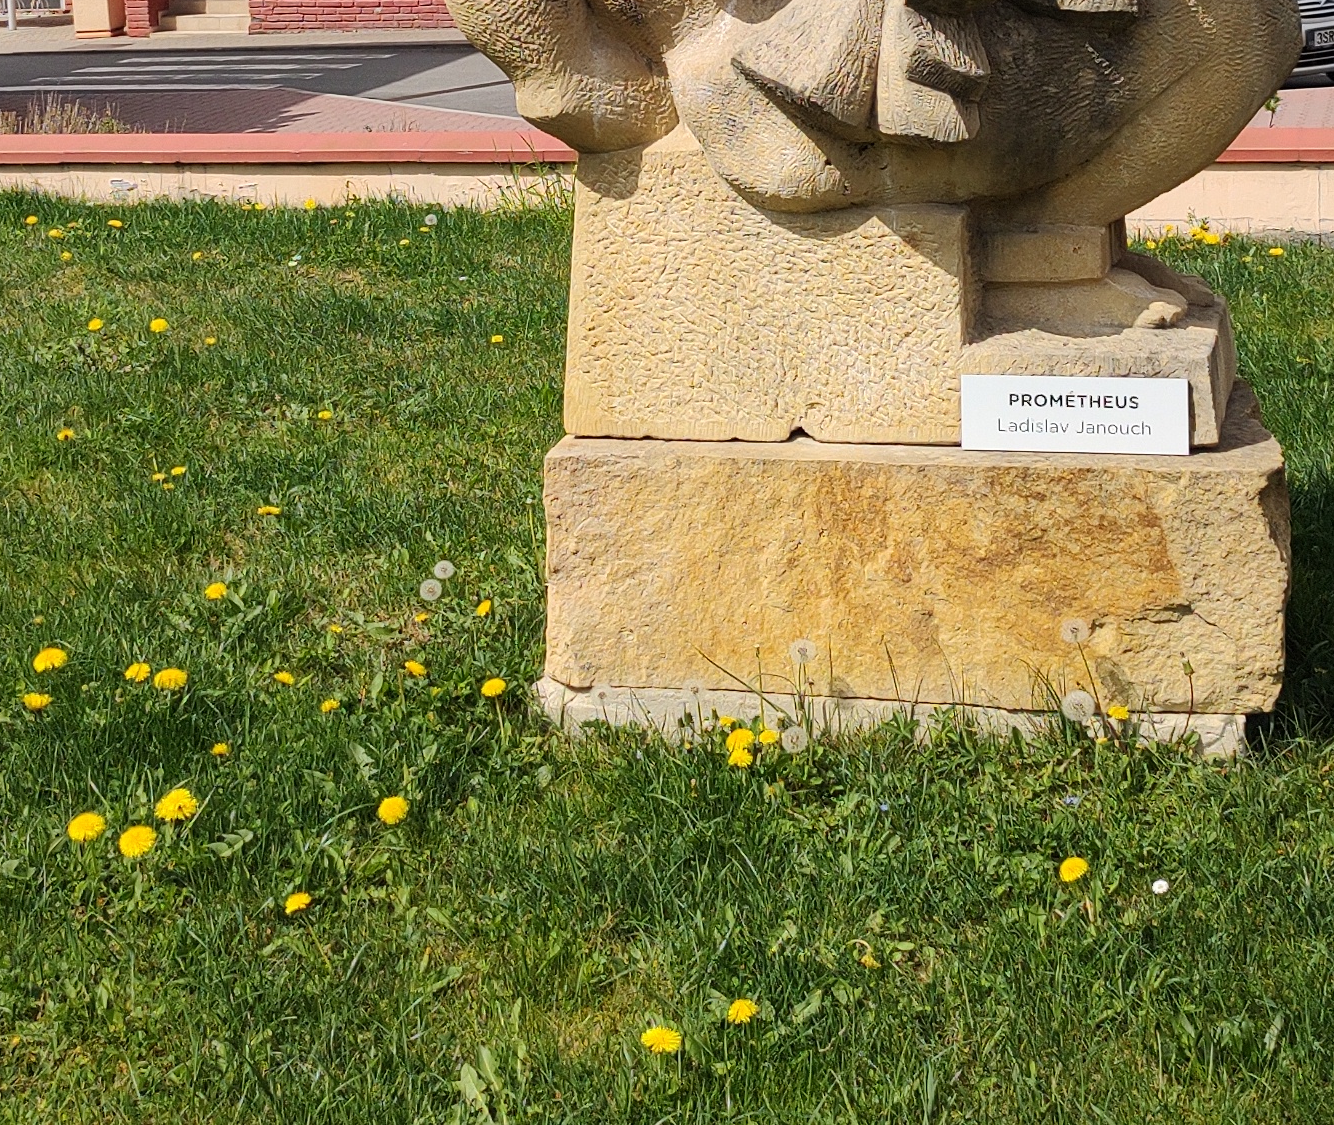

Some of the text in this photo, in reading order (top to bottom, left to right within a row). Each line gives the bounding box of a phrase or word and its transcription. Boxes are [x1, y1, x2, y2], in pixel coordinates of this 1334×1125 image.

[1316, 30, 1334, 45] 3SR
[1008, 390, 1140, 409] PROMÉTHEUS
[997, 417, 1152, 436] Ladislav Janouch
